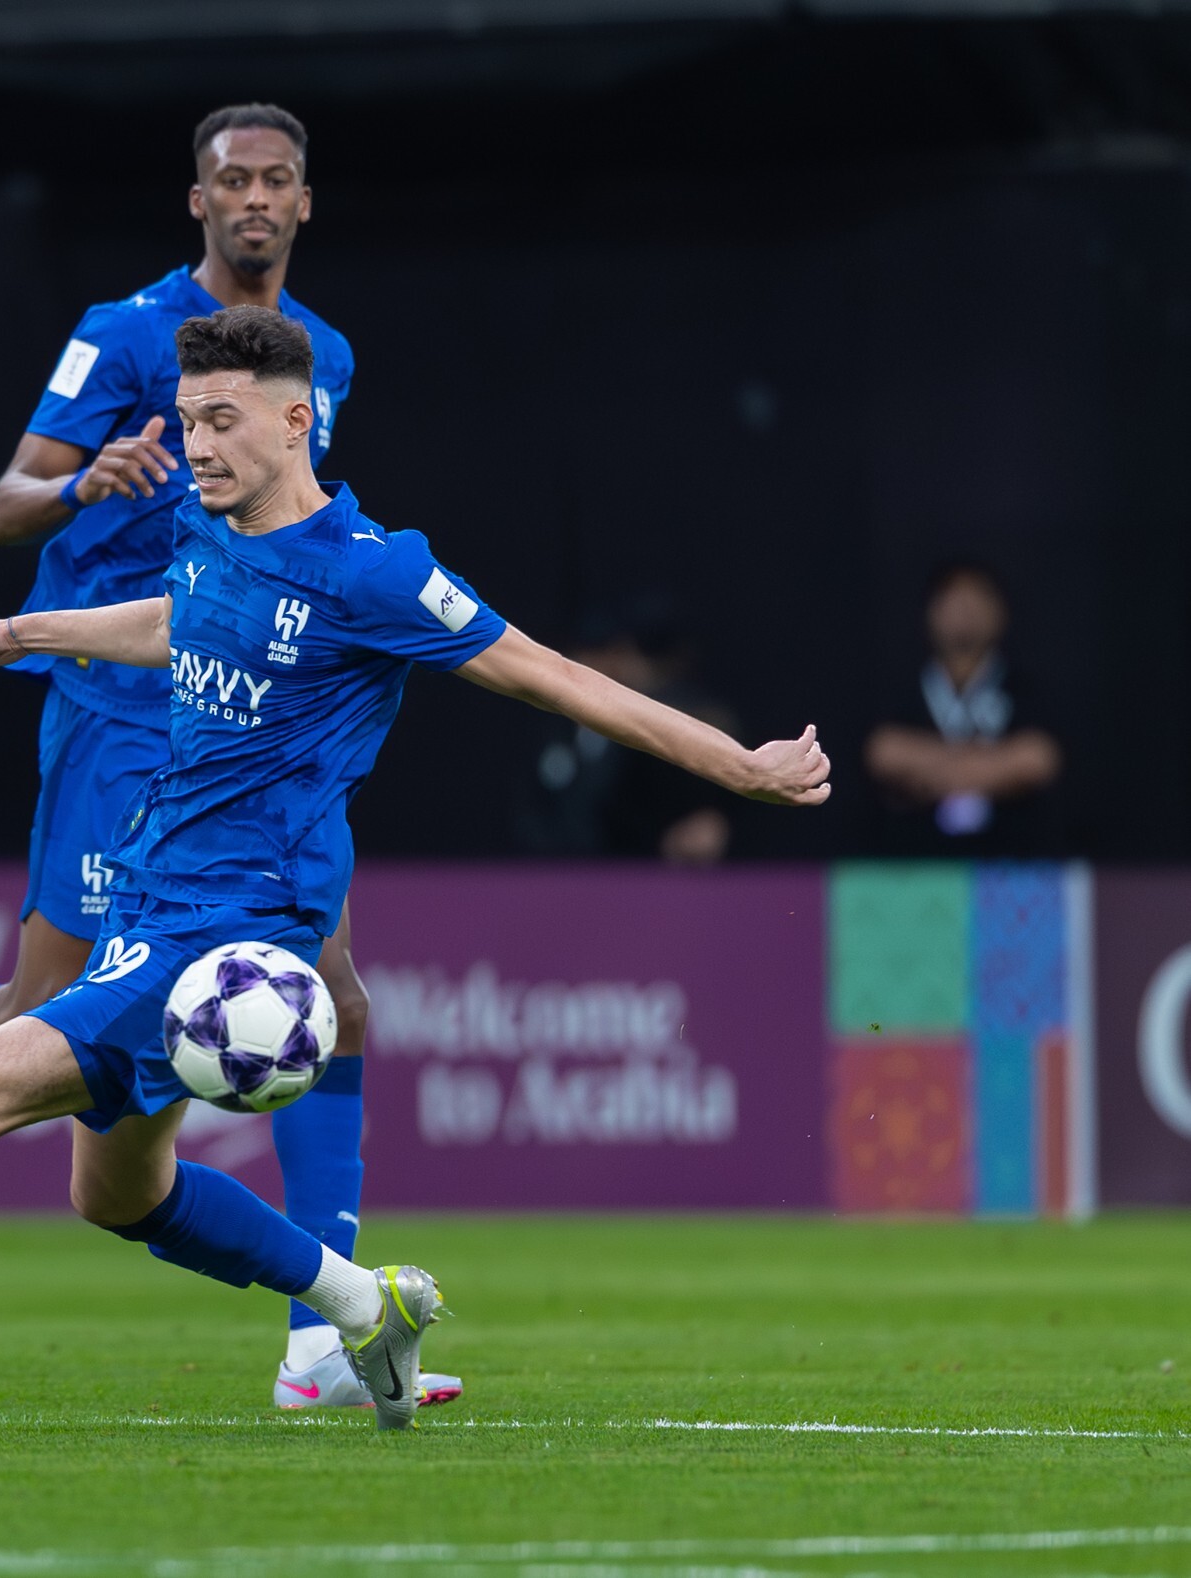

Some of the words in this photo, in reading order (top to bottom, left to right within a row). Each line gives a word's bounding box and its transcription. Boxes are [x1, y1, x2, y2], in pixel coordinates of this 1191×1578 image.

[268, 641, 299, 656] ALHILAL
[196, 699, 262, 728] GROUP
[364, 965, 686, 1058] Welcome
[418, 1063, 502, 1148] to
[508, 1055, 736, 1145] Arabia
